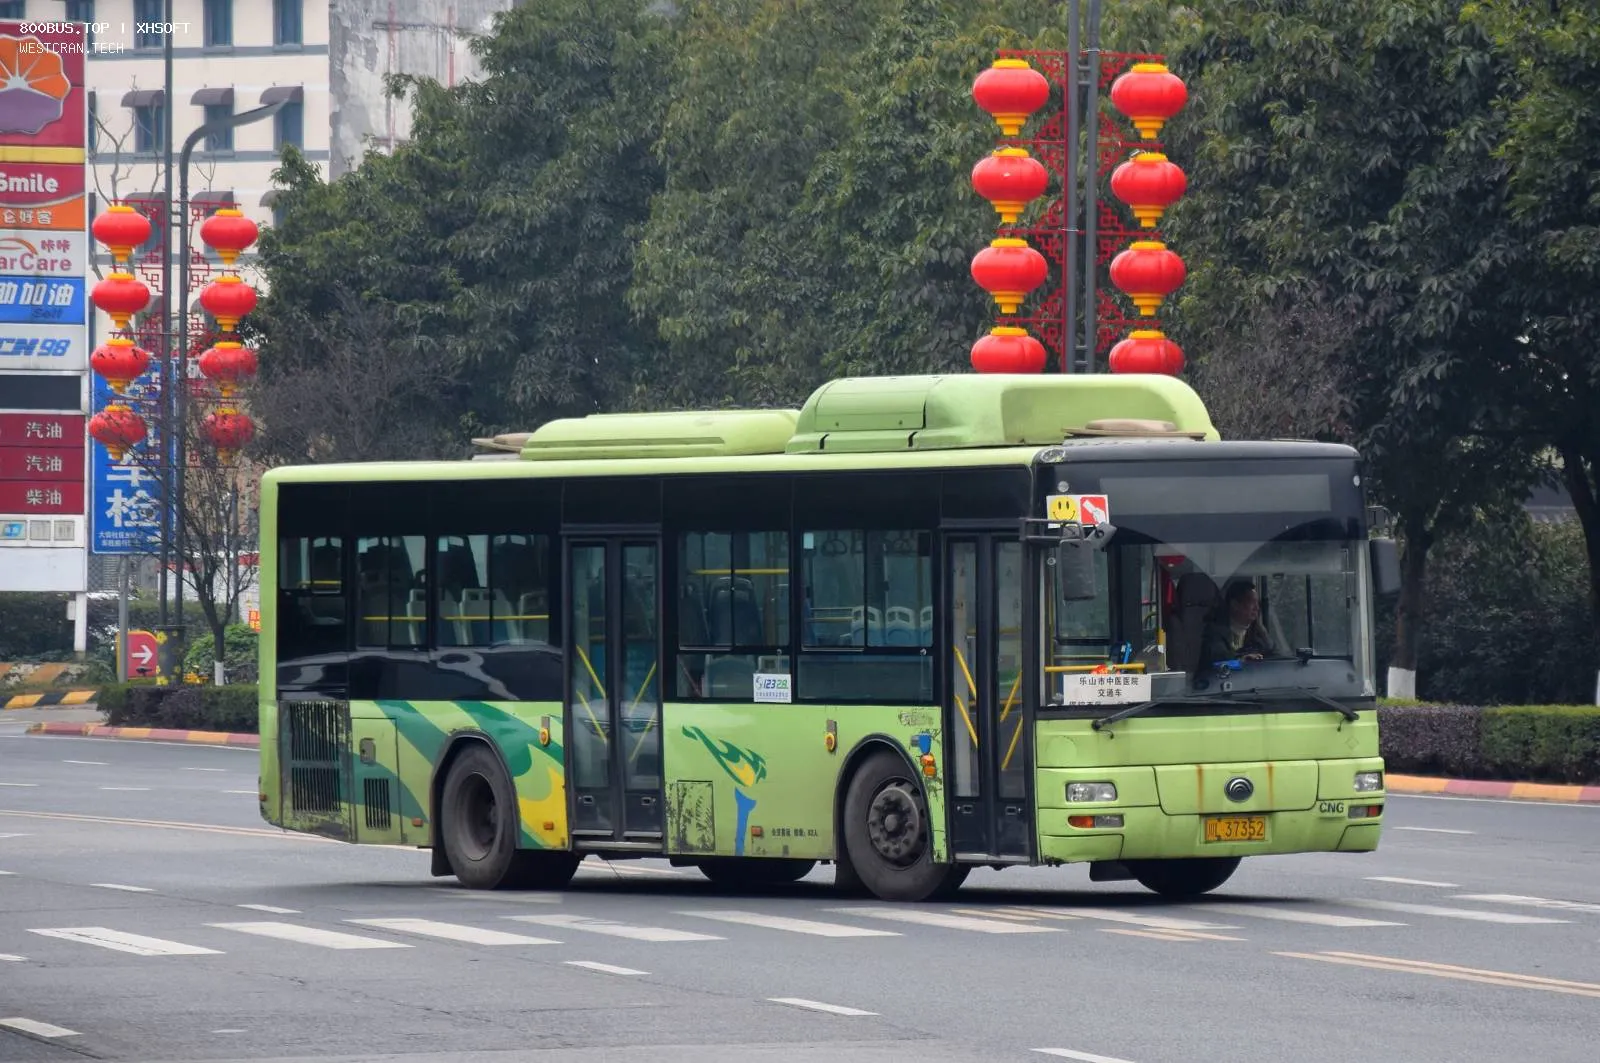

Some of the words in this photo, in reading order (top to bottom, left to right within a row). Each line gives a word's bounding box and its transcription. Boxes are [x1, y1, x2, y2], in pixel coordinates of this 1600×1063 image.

[26, 421, 62, 439] 汽油
[26, 455, 62, 472] 汽油
[26, 488, 62, 505] 柴油
[1079, 676, 1139, 686] 乐山市中医医院
[1097, 688, 1122, 698] 交通车
[1319, 802, 1344, 814] CNG
